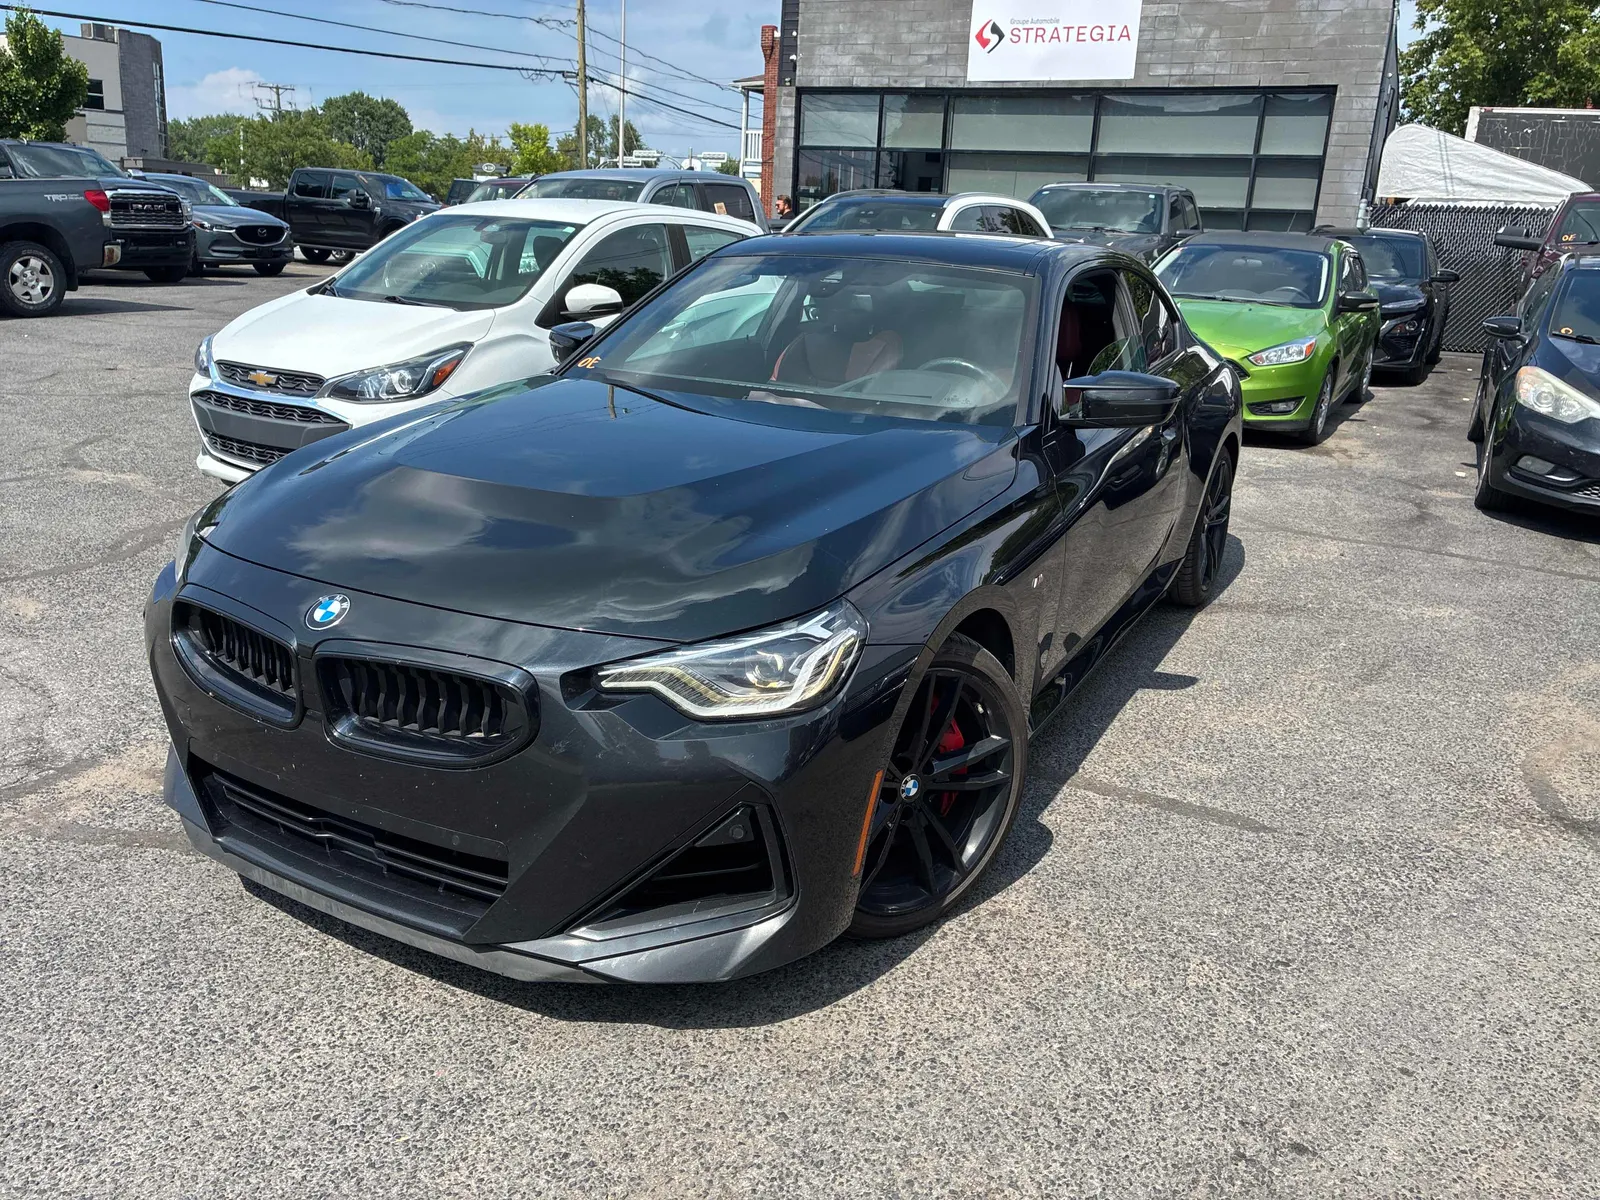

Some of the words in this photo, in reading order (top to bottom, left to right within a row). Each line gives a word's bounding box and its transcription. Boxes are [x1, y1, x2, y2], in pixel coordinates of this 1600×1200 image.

[1009, 25, 1131, 43] STRATEGIA
[44, 194, 68, 202] TRD
[132, 203, 164, 211] RAM
